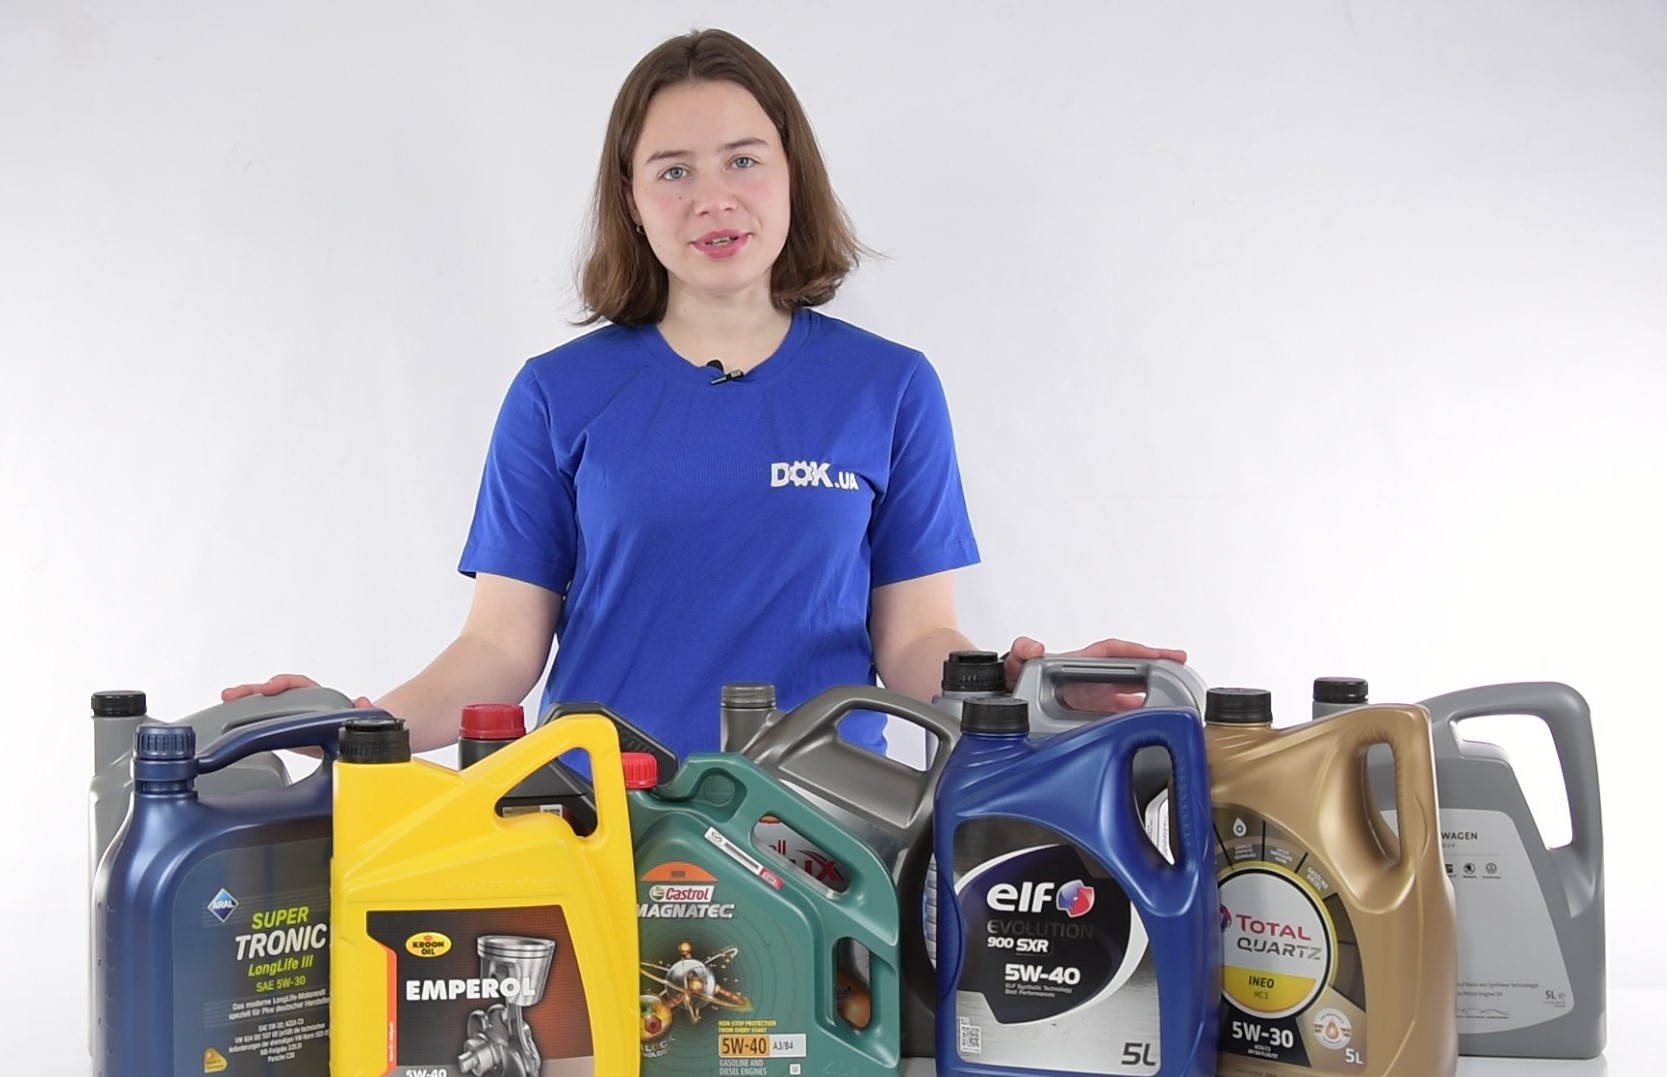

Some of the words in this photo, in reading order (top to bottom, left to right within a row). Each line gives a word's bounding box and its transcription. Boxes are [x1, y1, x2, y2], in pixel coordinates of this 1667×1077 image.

[665, 887, 709, 901] Castrol
[986, 881, 1055, 913] elf
[212, 899, 235, 910] ARAL
[637, 903, 735, 918] MAGNATEC
[251, 906, 309, 930] SUPER
[1236, 914, 1311, 941] TOTAL
[987, 919, 1094, 939] EVOLUTION
[235, 923, 327, 961] TRONIC
[987, 936, 1014, 949] 900
[1016, 938, 1049, 953] SXR
[1237, 936, 1322, 960] QUARTZ
[248, 957, 299, 977] LongLife
[300, 954, 314, 969] III
[1005, 963, 1081, 985] 5W-40
[256, 981, 275, 993] SAE
[276, 975, 306, 990] 5W-30
[406, 977, 536, 1001] EMPEROL
[1248, 975, 1275, 989] INEO
[1232, 1021, 1294, 1048] 5W-30
[722, 1037, 767, 1055] 5W-40
[773, 1041, 794, 1051] A3/B4
[1121, 1042, 1156, 1067] 5L
[1345, 1048, 1363, 1064] 5L
[719, 1059, 750, 1067] GASOLINE
[750, 1059, 764, 1067] AND
[719, 1067, 740, 1076] DIESEL
[741, 1067, 767, 1076] ENGINES
